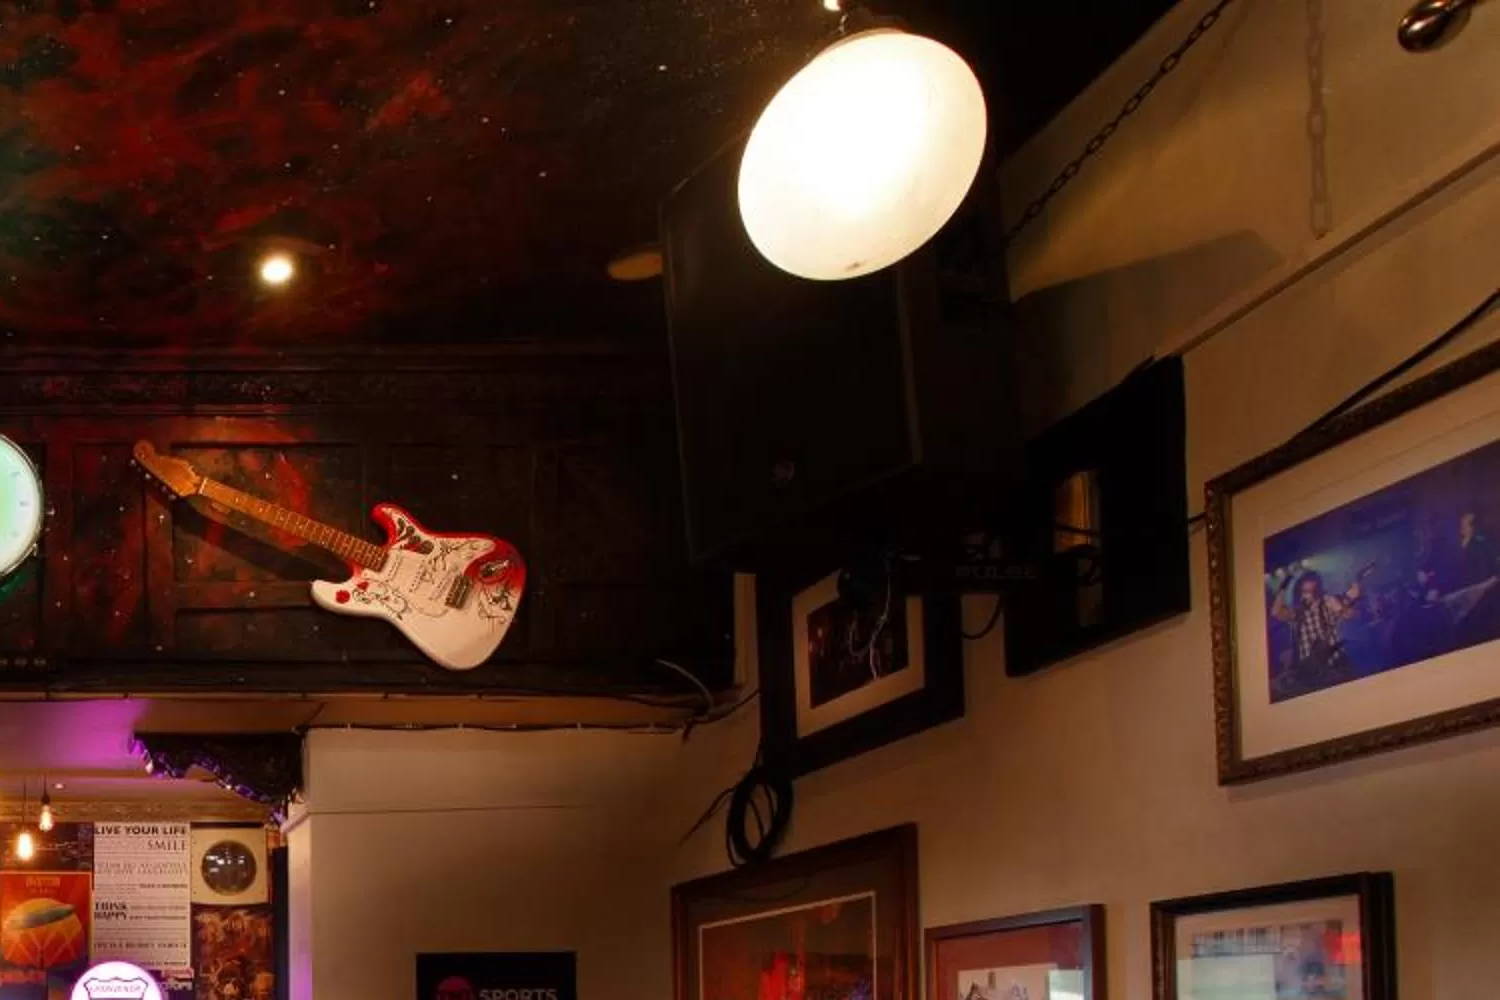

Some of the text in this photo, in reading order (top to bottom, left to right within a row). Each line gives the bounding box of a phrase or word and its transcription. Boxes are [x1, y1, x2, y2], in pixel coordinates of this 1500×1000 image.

[94, 825, 187, 835] LIVE YOUR LIFE
[147, 839, 187, 851] SMILE
